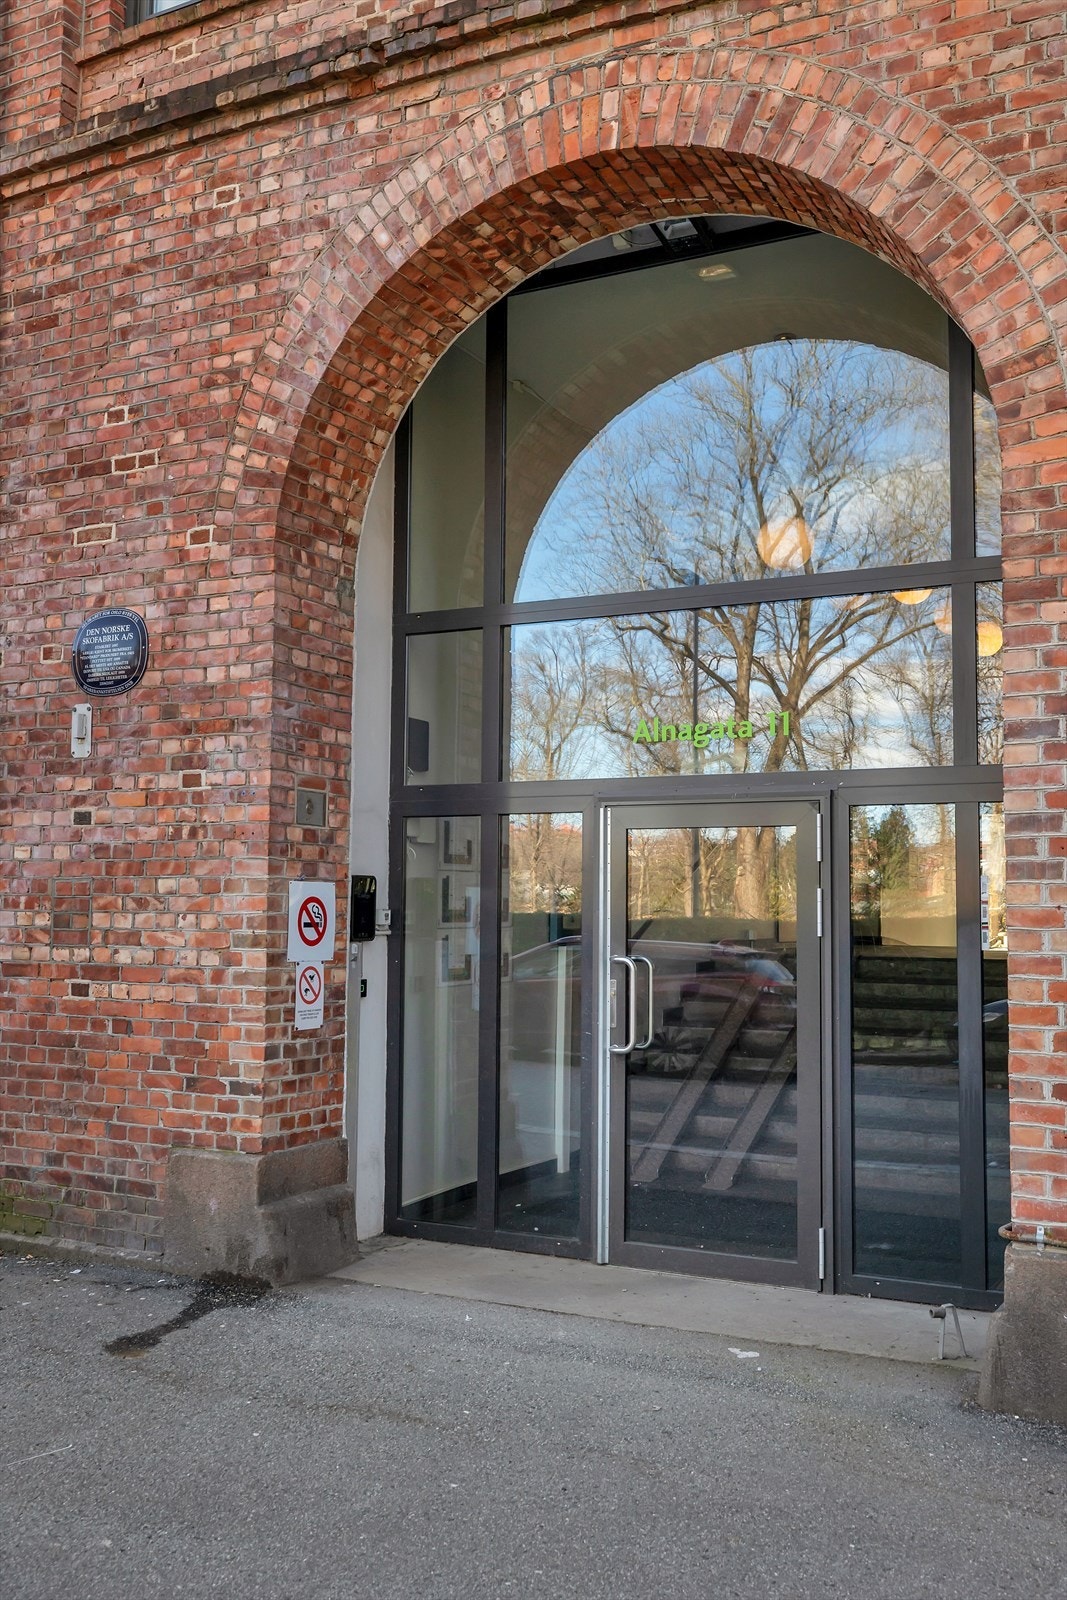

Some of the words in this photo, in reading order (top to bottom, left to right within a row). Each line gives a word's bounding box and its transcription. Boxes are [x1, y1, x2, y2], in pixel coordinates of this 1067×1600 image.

[86, 628, 101, 636] DEN
[101, 625, 130, 634] NORSKE
[82, 634, 120, 645] SKOFABRIK
[121, 633, 134, 641] A/S
[632, 715, 753, 748] Alnagata
[765, 710, 790, 736] 11
